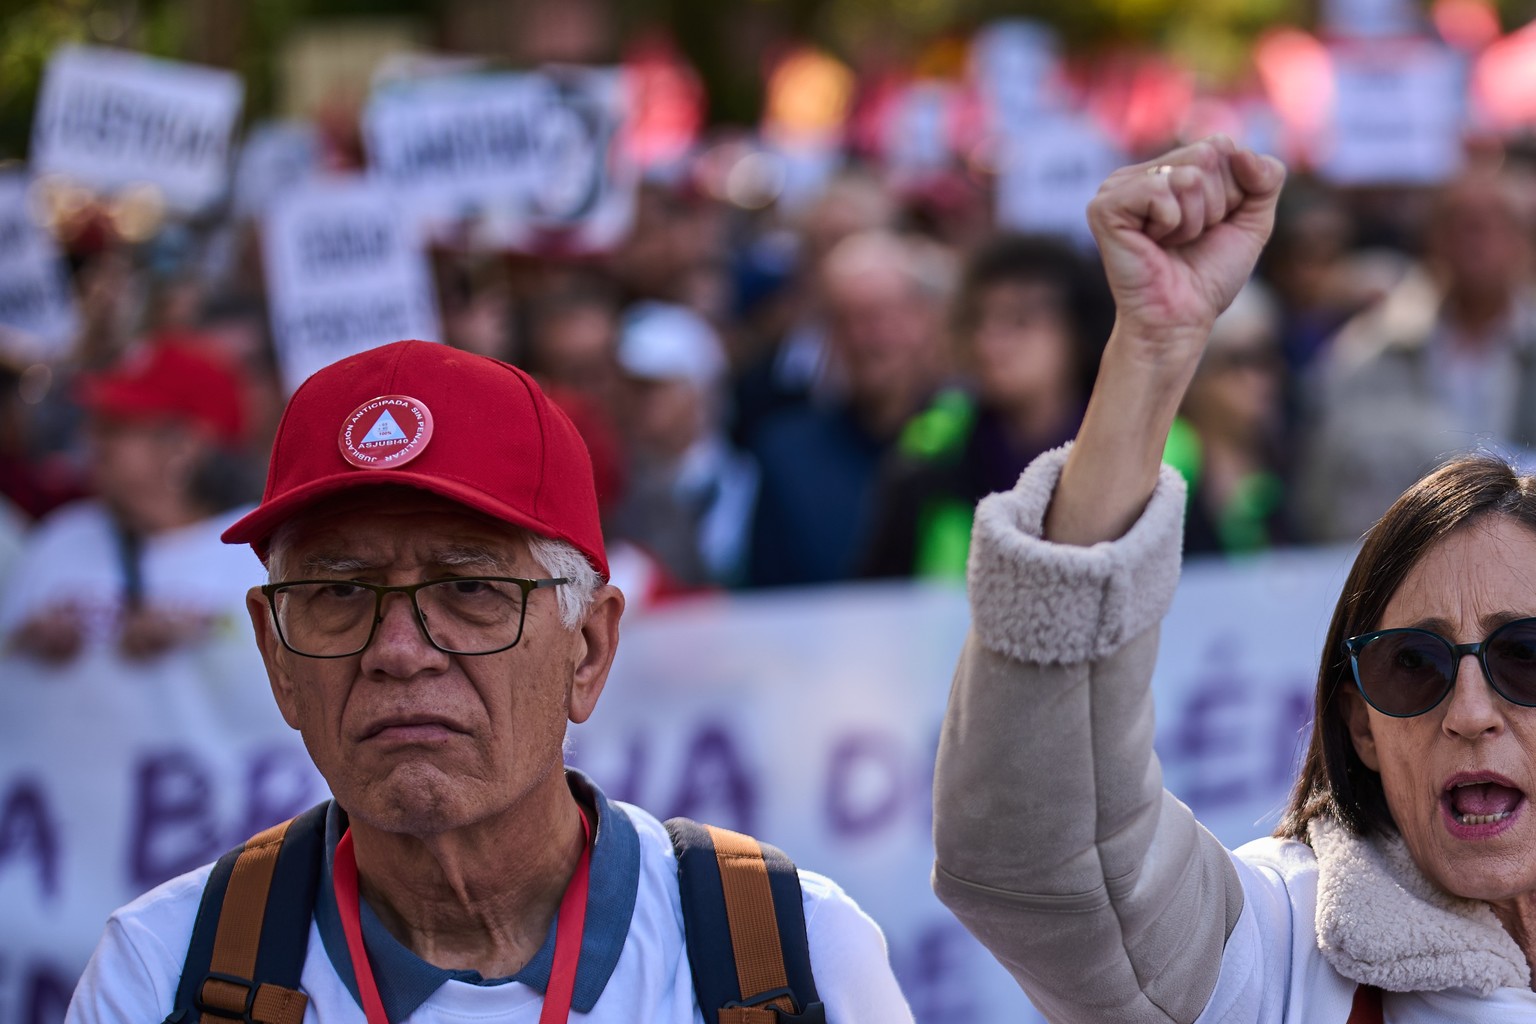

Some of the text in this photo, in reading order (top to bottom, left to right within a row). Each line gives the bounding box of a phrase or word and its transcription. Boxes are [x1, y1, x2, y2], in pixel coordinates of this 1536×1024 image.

[352, 399, 409, 424] ANTICIPADA
[411, 407, 423, 420] SIN
[357, 438, 409, 450] ASJUBI40
[384, 421, 425, 462] PENALIZAR
